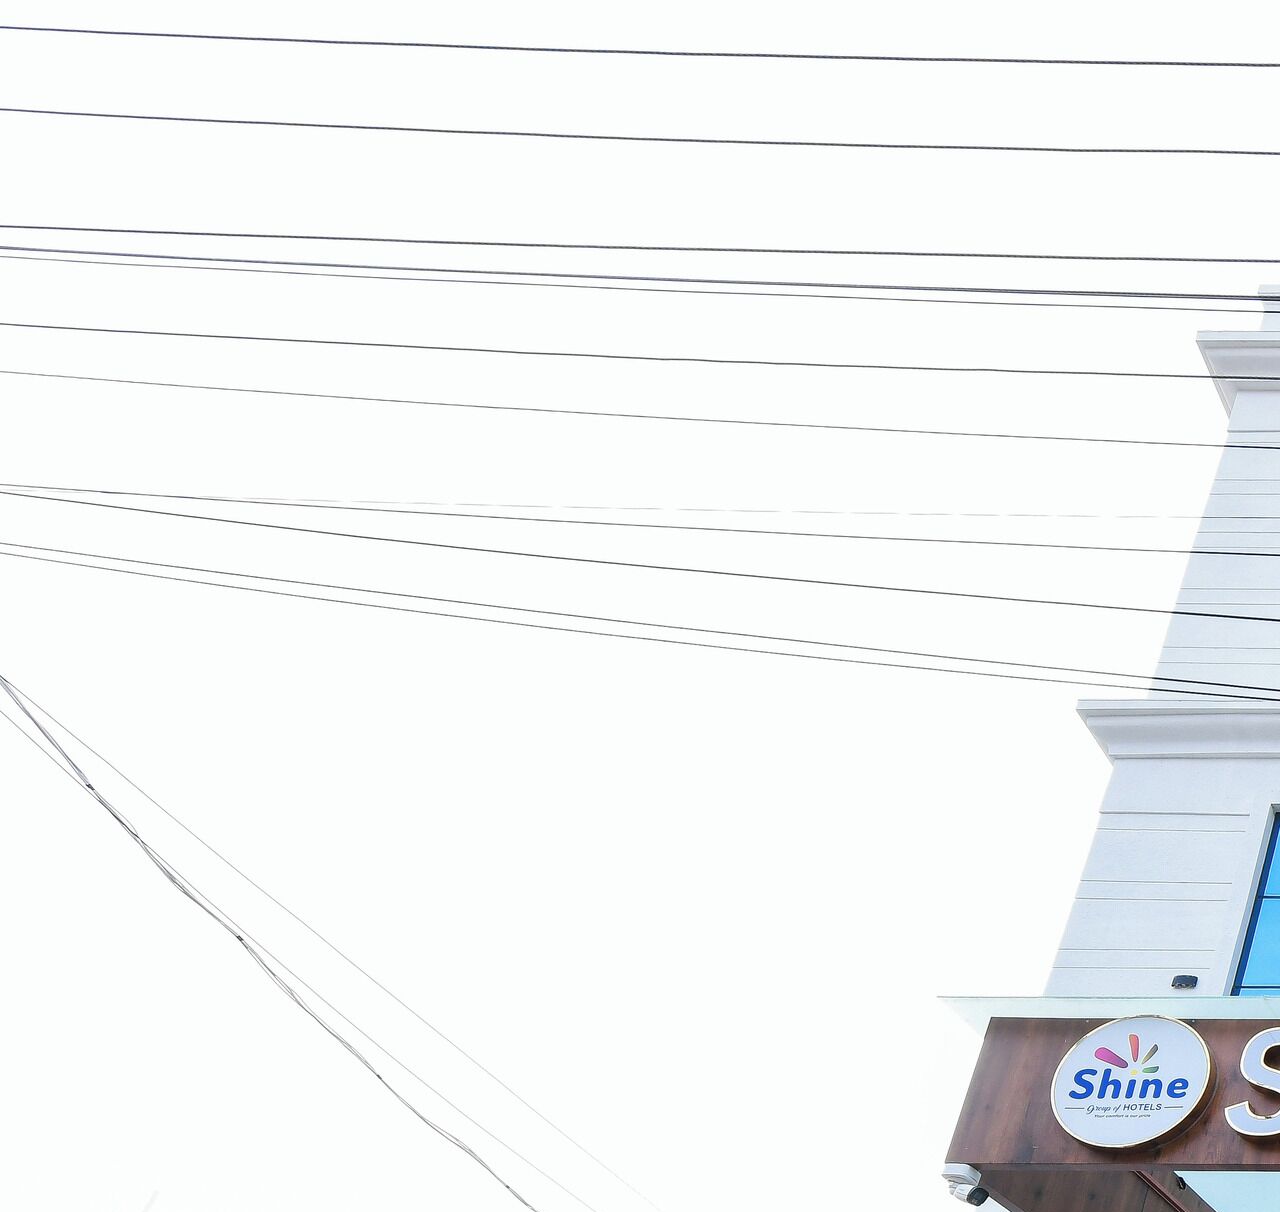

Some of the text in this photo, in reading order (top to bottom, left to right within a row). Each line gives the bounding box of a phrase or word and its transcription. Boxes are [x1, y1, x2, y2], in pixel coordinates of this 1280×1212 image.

[1068, 1068, 1189, 1099] Shine
[1086, 1103, 1162, 1115] Group of HOTELS
